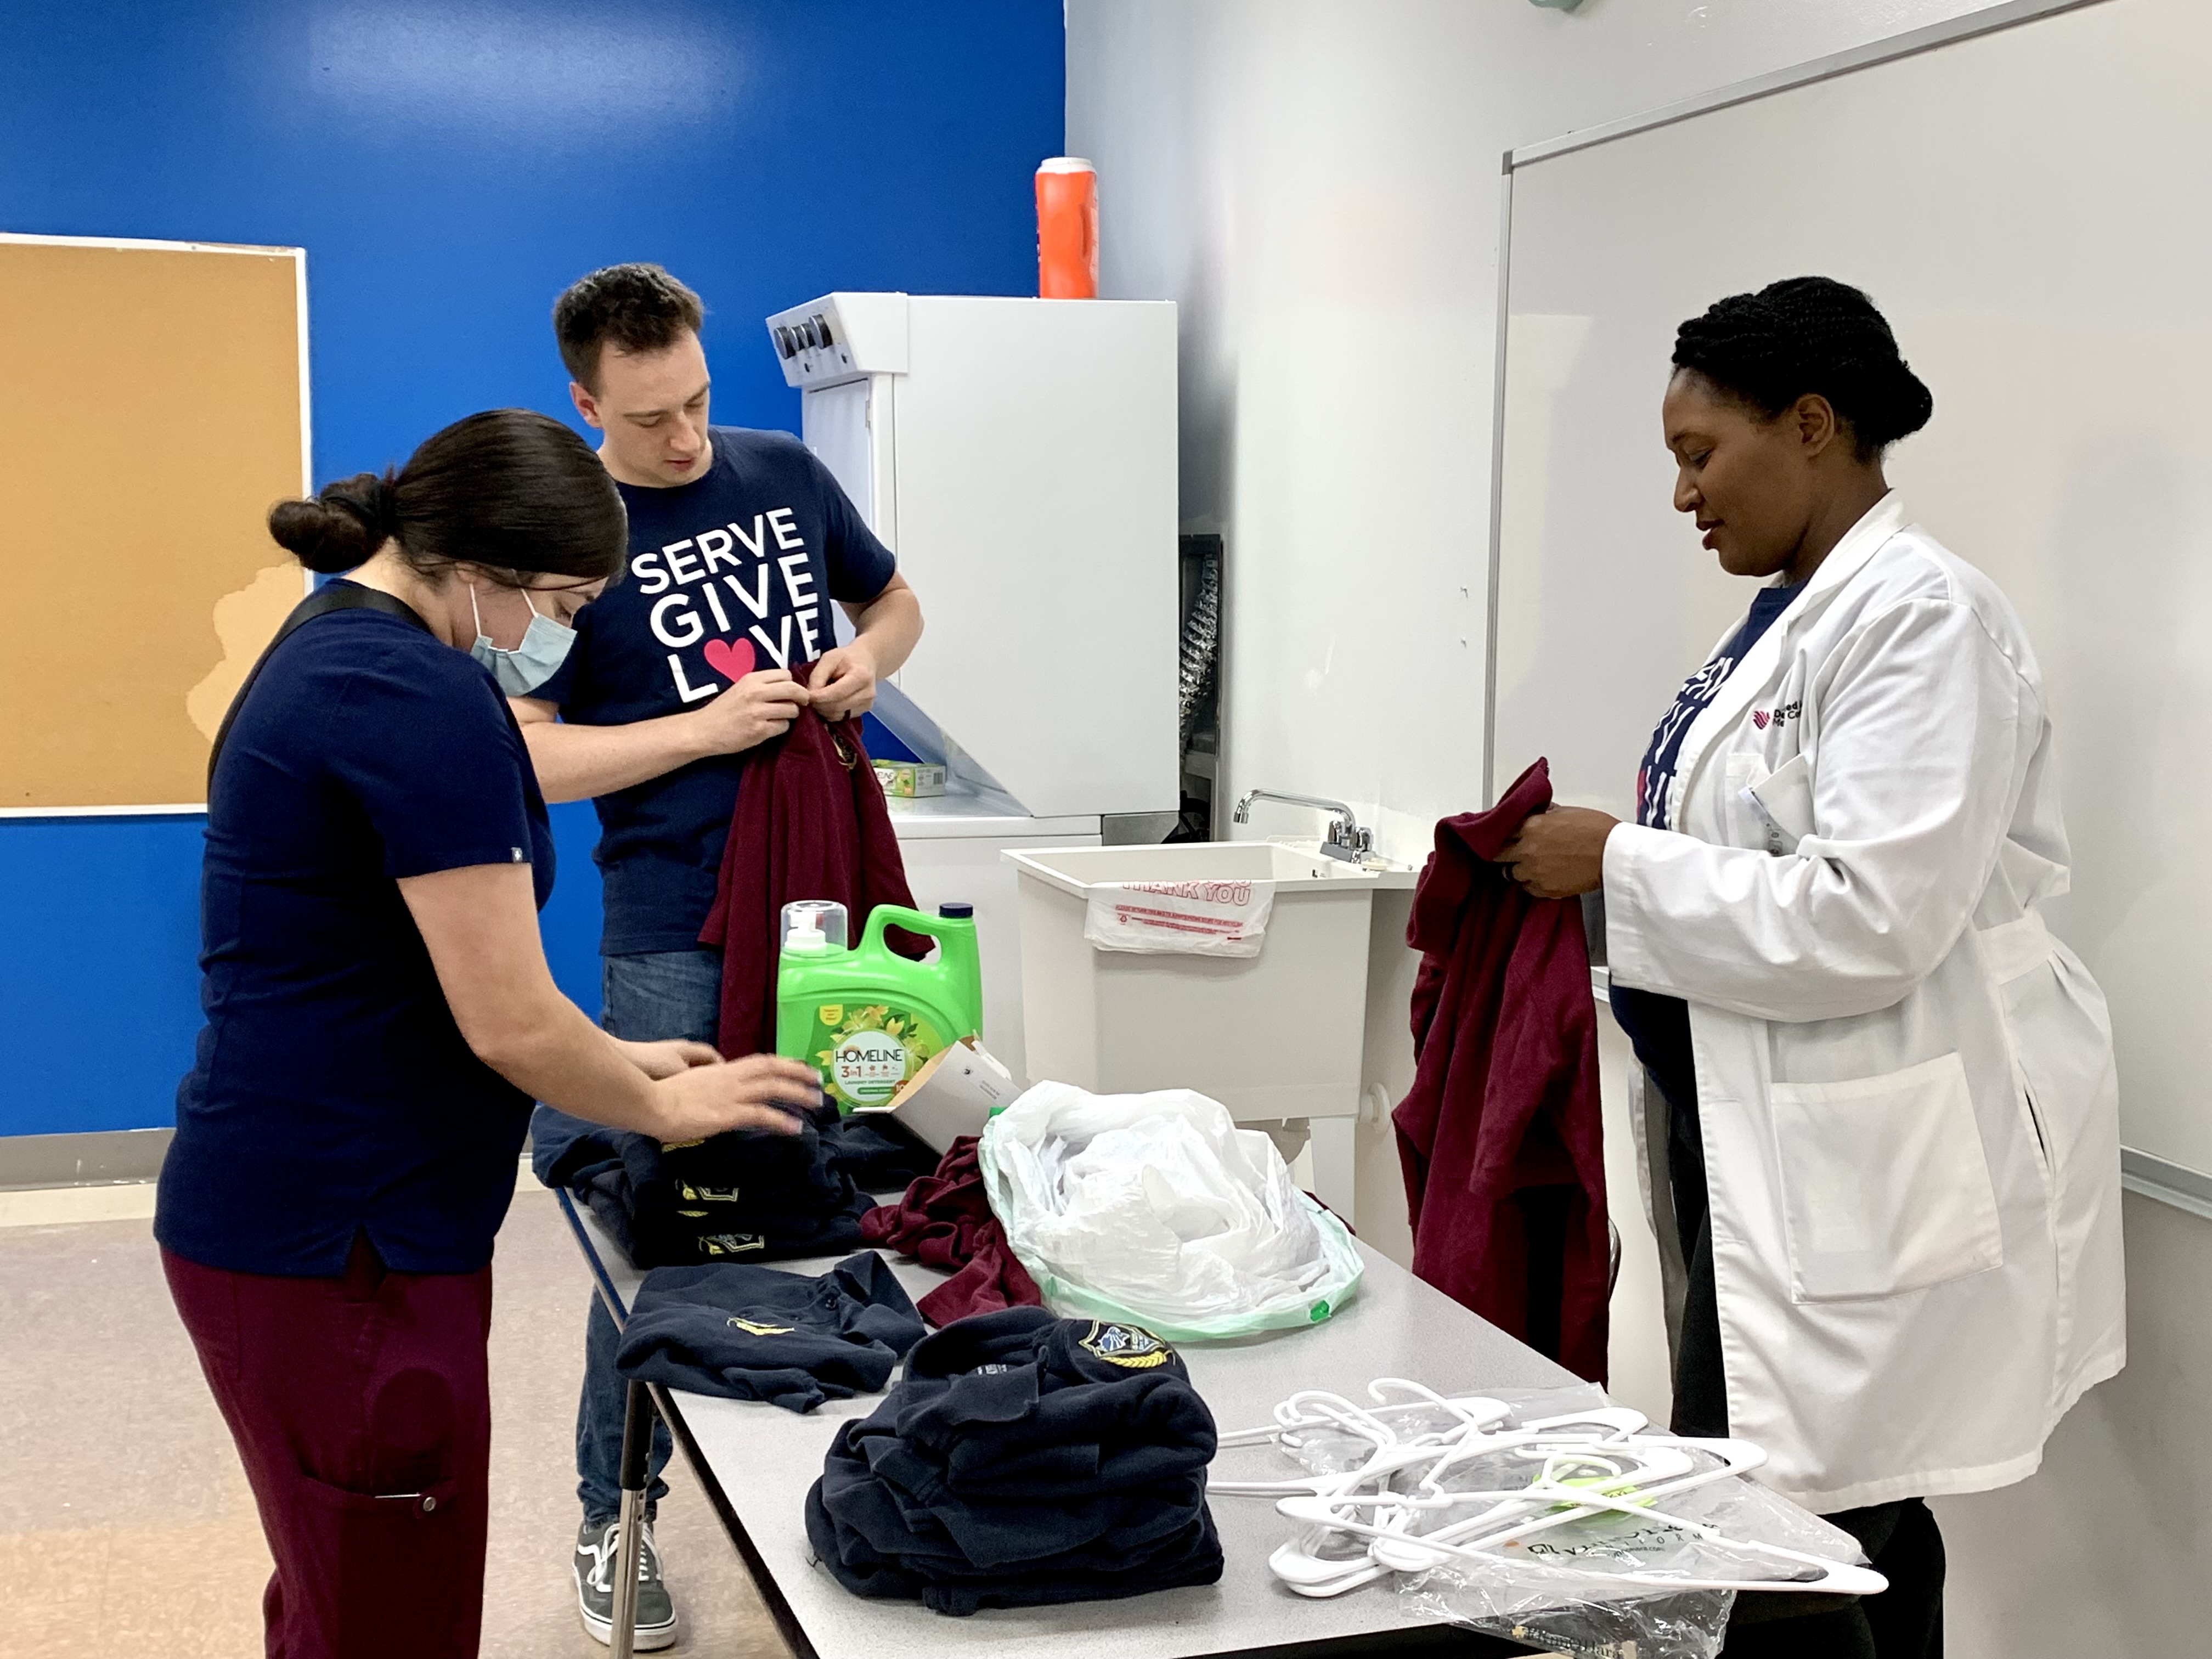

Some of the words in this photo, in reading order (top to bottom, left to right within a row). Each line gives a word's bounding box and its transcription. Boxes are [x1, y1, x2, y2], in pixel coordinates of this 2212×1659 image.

[631, 507, 804, 594] SERVE
[650, 552, 818, 648] GIVE
[1203, 882, 1251, 906] YOU
[836, 1049, 904, 1063] HOMELINE
